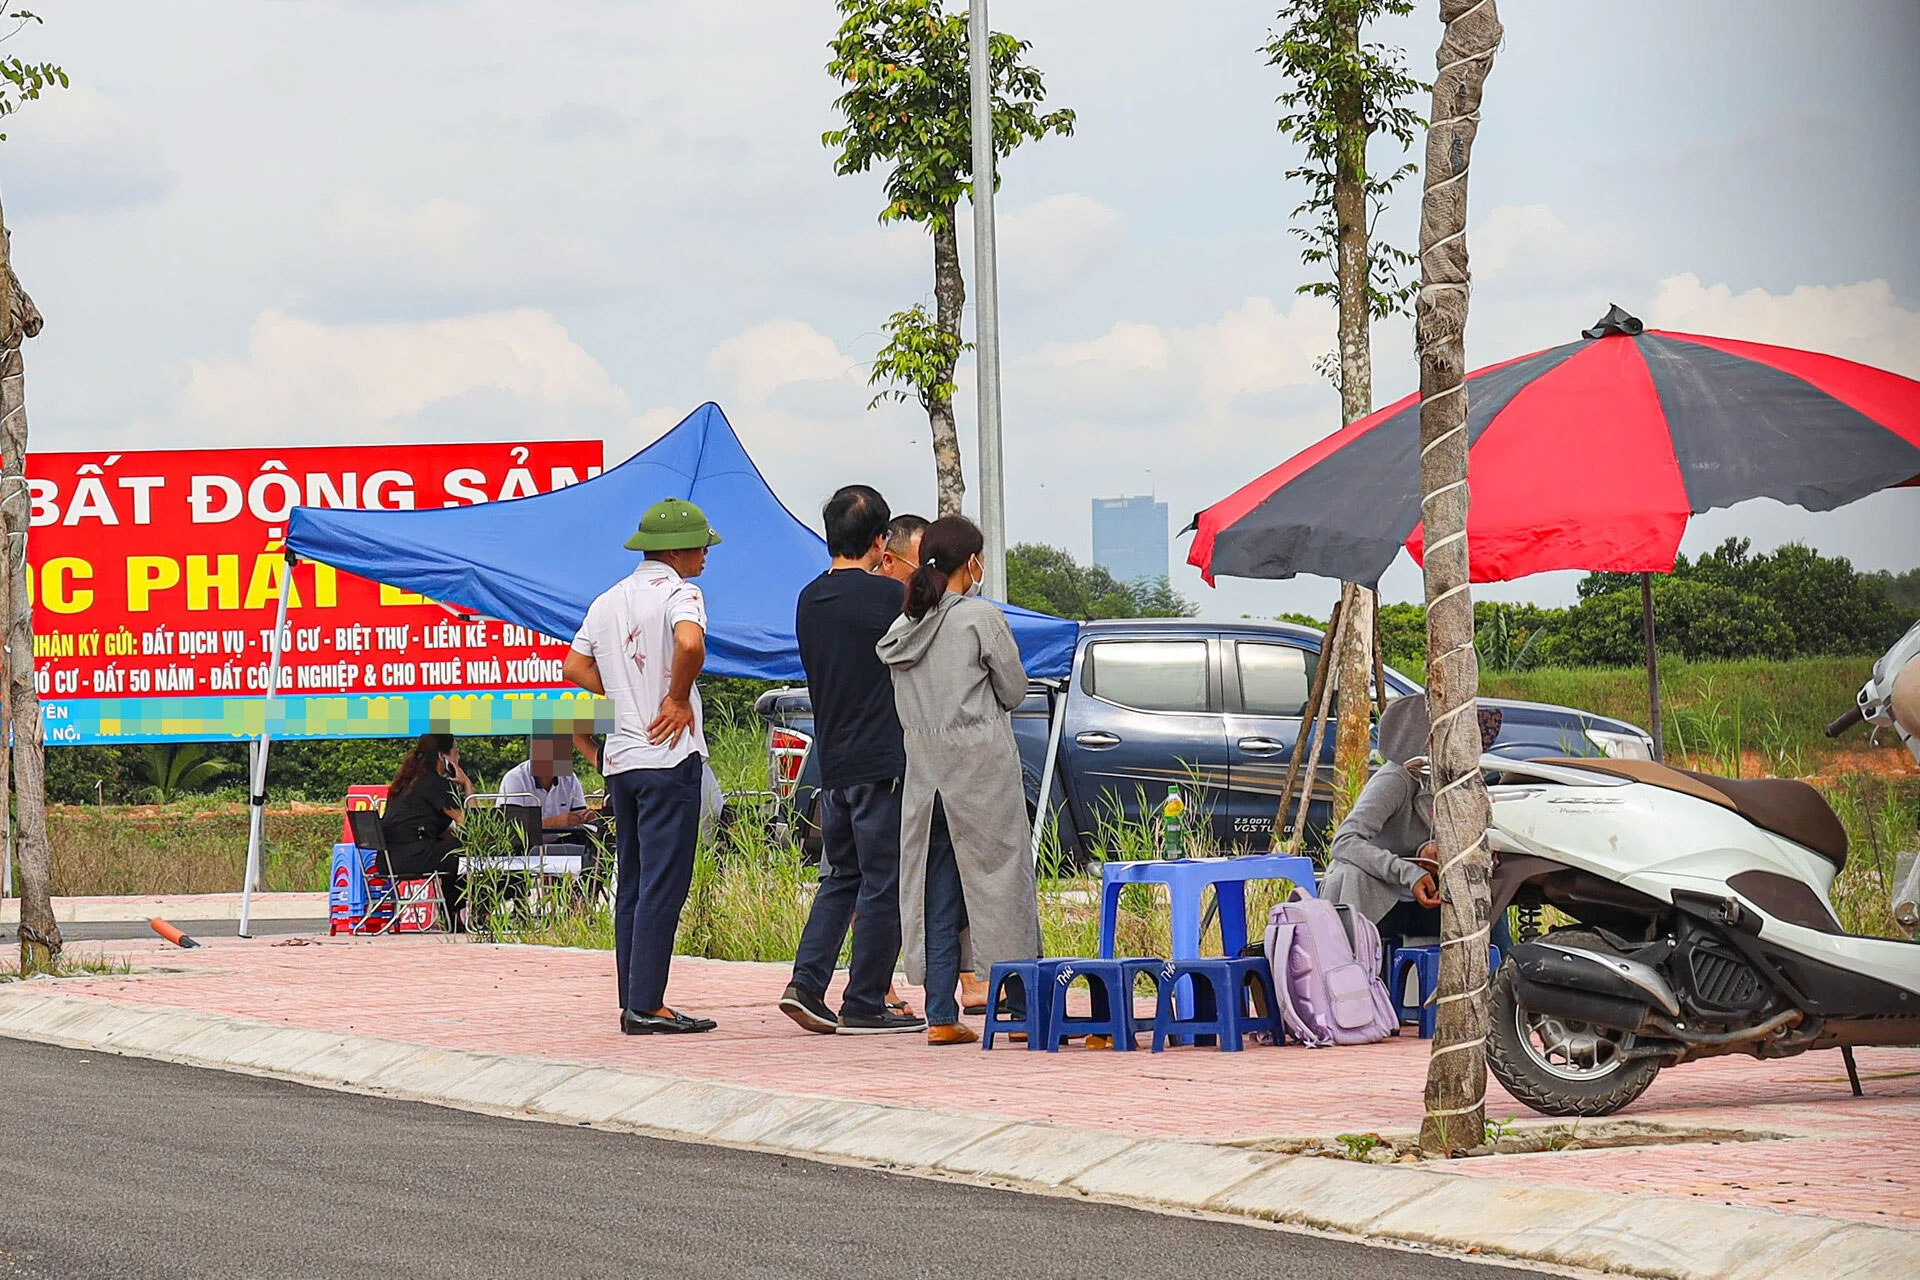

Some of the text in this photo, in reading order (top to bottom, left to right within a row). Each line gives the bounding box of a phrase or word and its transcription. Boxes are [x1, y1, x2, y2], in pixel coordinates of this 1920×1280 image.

[29, 454, 166, 527] BẤT
[186, 459, 415, 540] ĐỘNG
[78, 628, 100, 657] KÝ
[142, 623, 175, 655] ĐẤT
[178, 630, 218, 660] DỊCH
[222, 630, 245, 659] VỤ
[296, 626, 321, 653] CƯ
[335, 622, 372, 656] BIỆT
[375, 624, 410, 655] THỰ
[423, 618, 460, 649] LIỀN
[54, 667, 80, 694] CƯ
[93, 661, 126, 693] ĐẤT
[129, 668, 151, 692] 50
[154, 663, 195, 692] NĂM
[210, 659, 243, 690] ĐẤT
[297, 659, 359, 693] NGHIỆP
[363, 663, 377, 687] &
[381, 662, 416, 687] CHO
[420, 657, 462, 686] THUÊ
[466, 656, 503, 685] NHÀ
[505, 652, 565, 683] XƯỞNG
